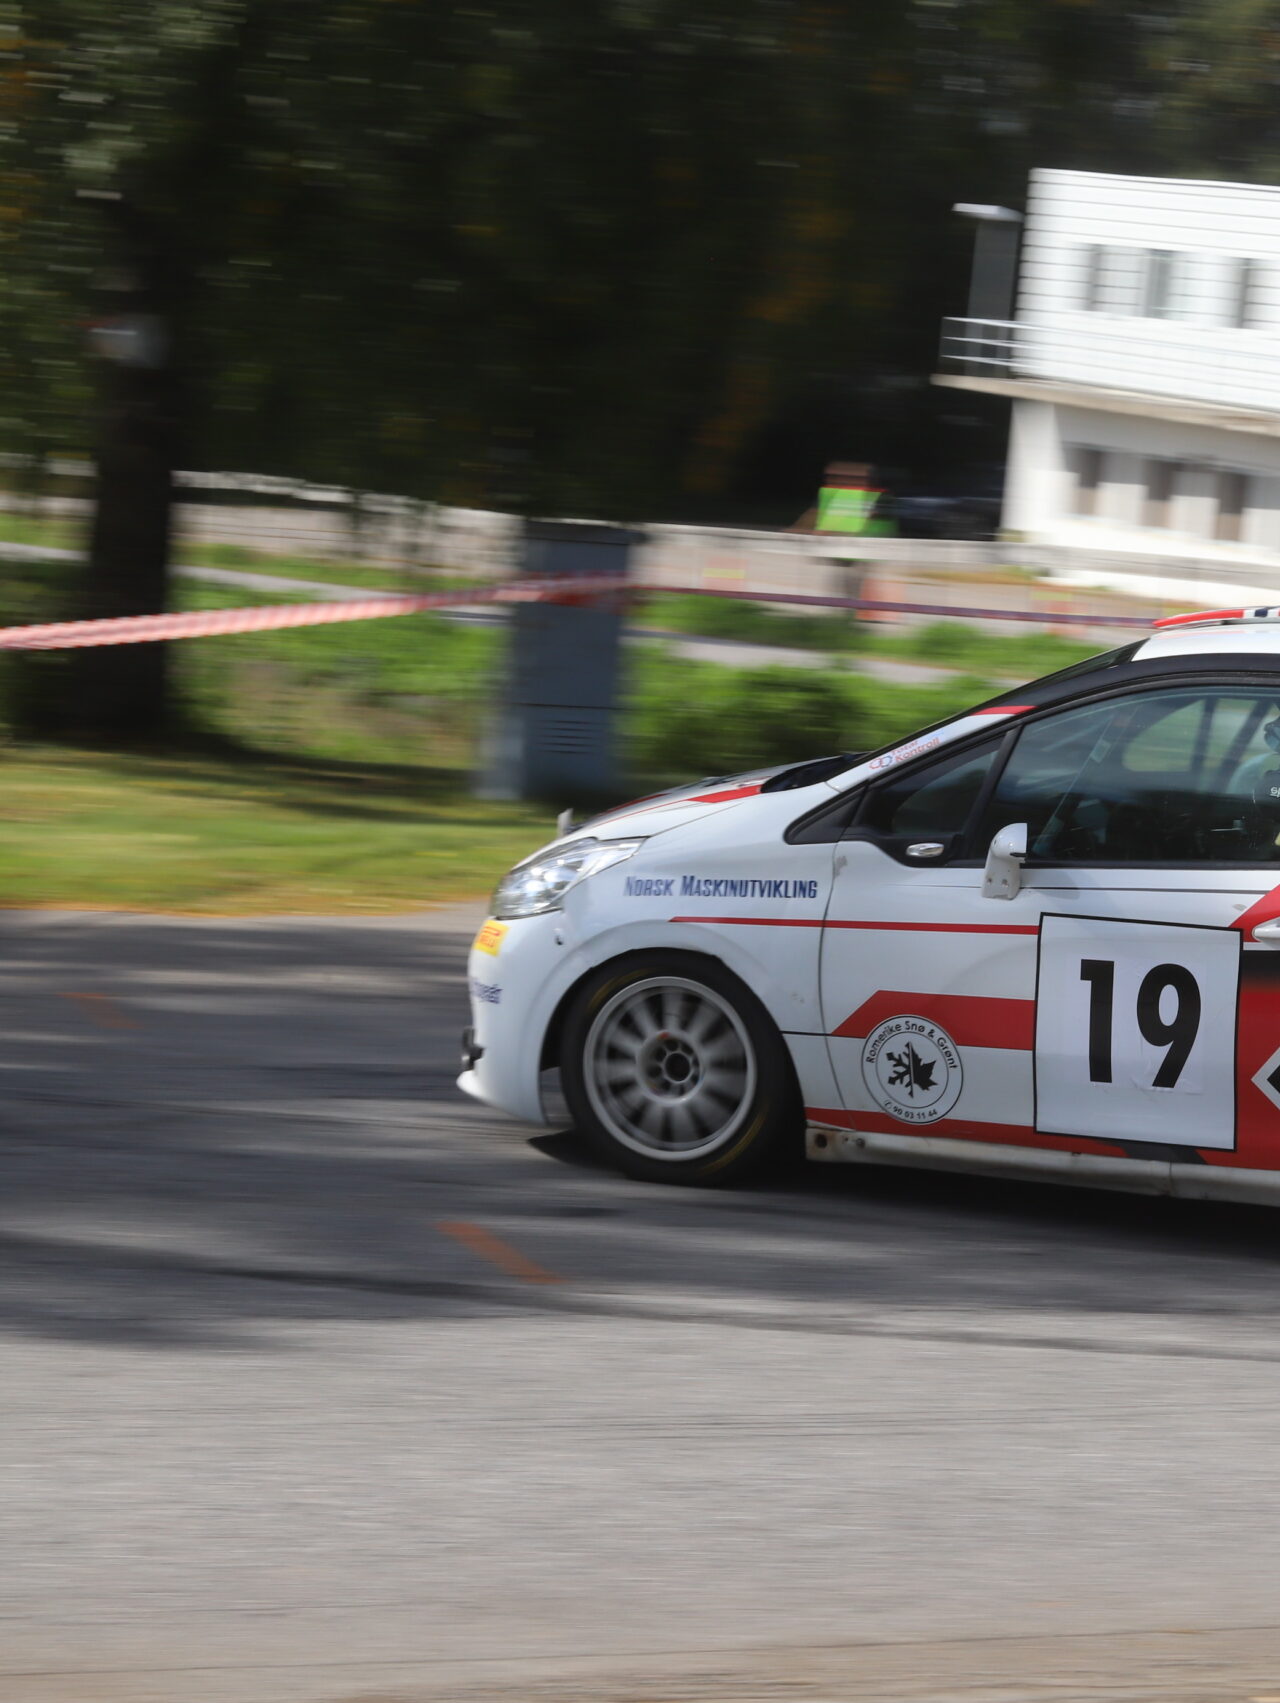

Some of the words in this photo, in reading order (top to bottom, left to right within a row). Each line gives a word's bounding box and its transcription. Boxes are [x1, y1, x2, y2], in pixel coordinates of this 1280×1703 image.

[679, 875, 818, 899] MASKINUTVIKLING
[866, 1023, 902, 1064] Romerike
[904, 1020, 925, 1032] Snø
[928, 1029, 935, 1038] &
[937, 1037, 958, 1069] Grønt
[1080, 958, 1201, 1089] 19
